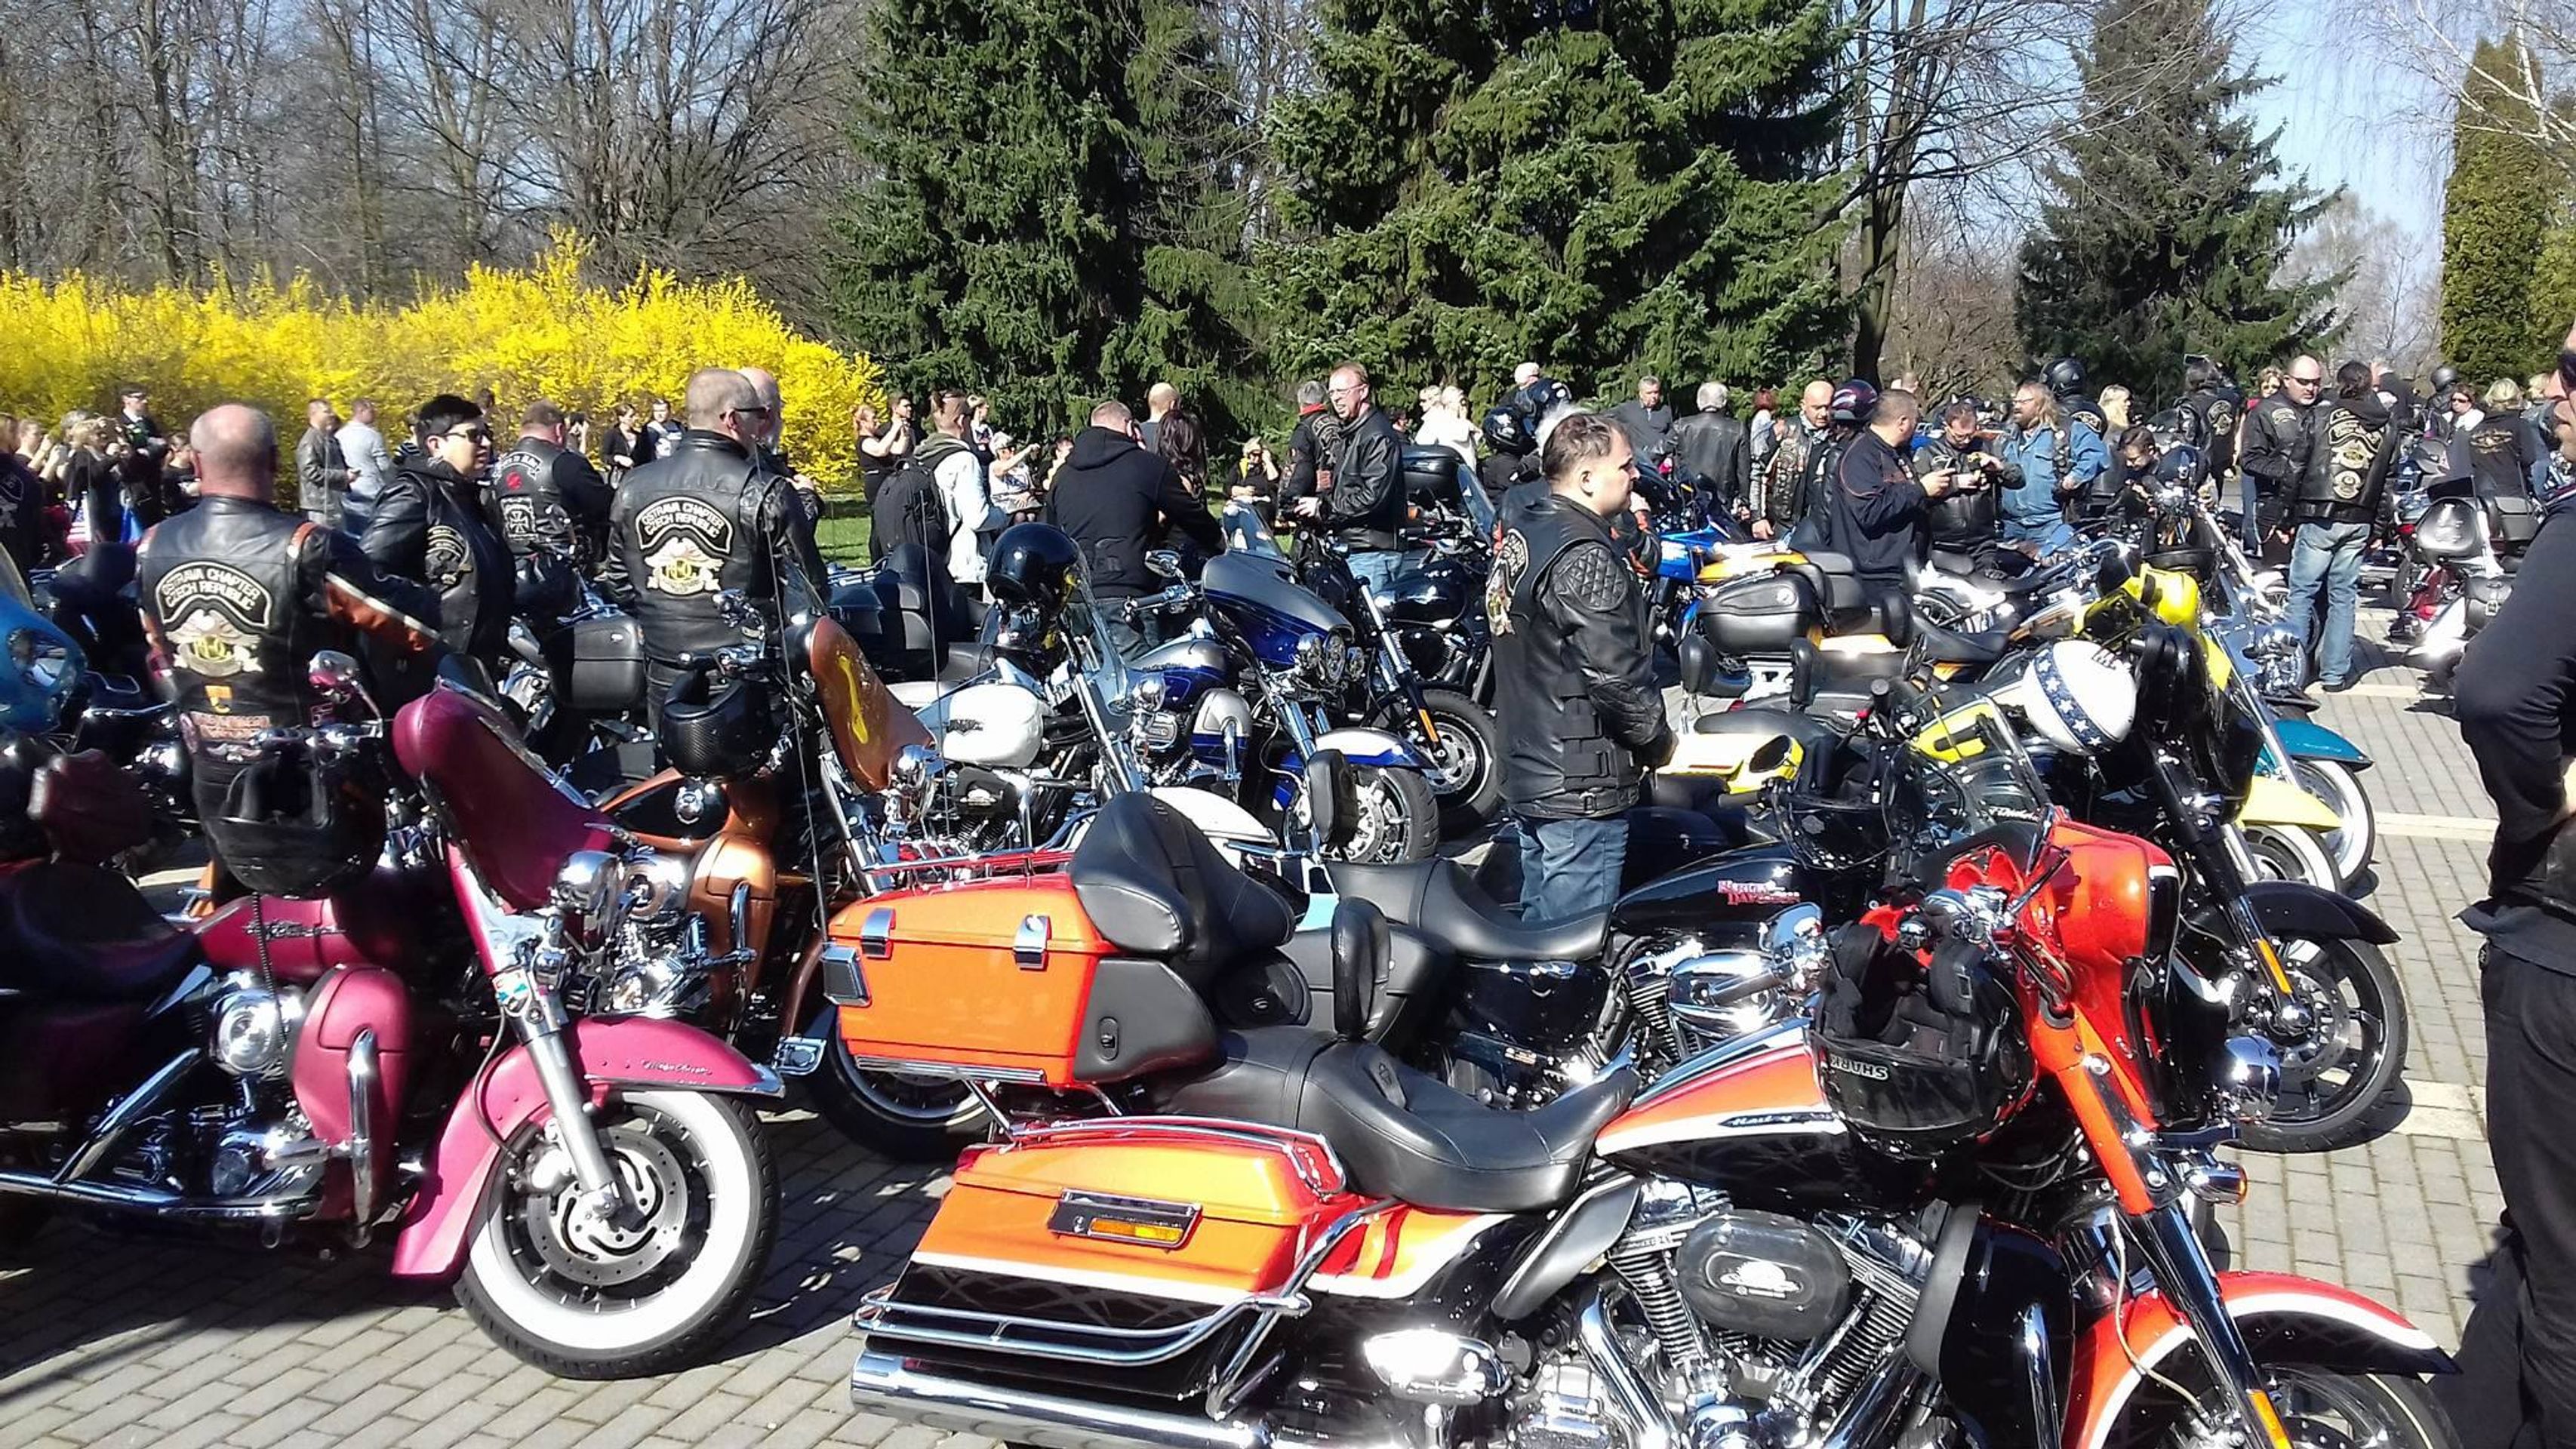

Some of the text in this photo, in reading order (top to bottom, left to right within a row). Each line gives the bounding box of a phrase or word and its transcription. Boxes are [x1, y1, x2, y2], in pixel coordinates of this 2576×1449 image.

[642, 502, 725, 529] OSTRAVA CHAPTER
[644, 513, 720, 538] CZECH REPUBLIC
[162, 568, 261, 601] OSTRAVA CHAPTER
[165, 580, 256, 611] CZECH REPUBLIC
[1830, 1054, 1888, 1081] SHARK
